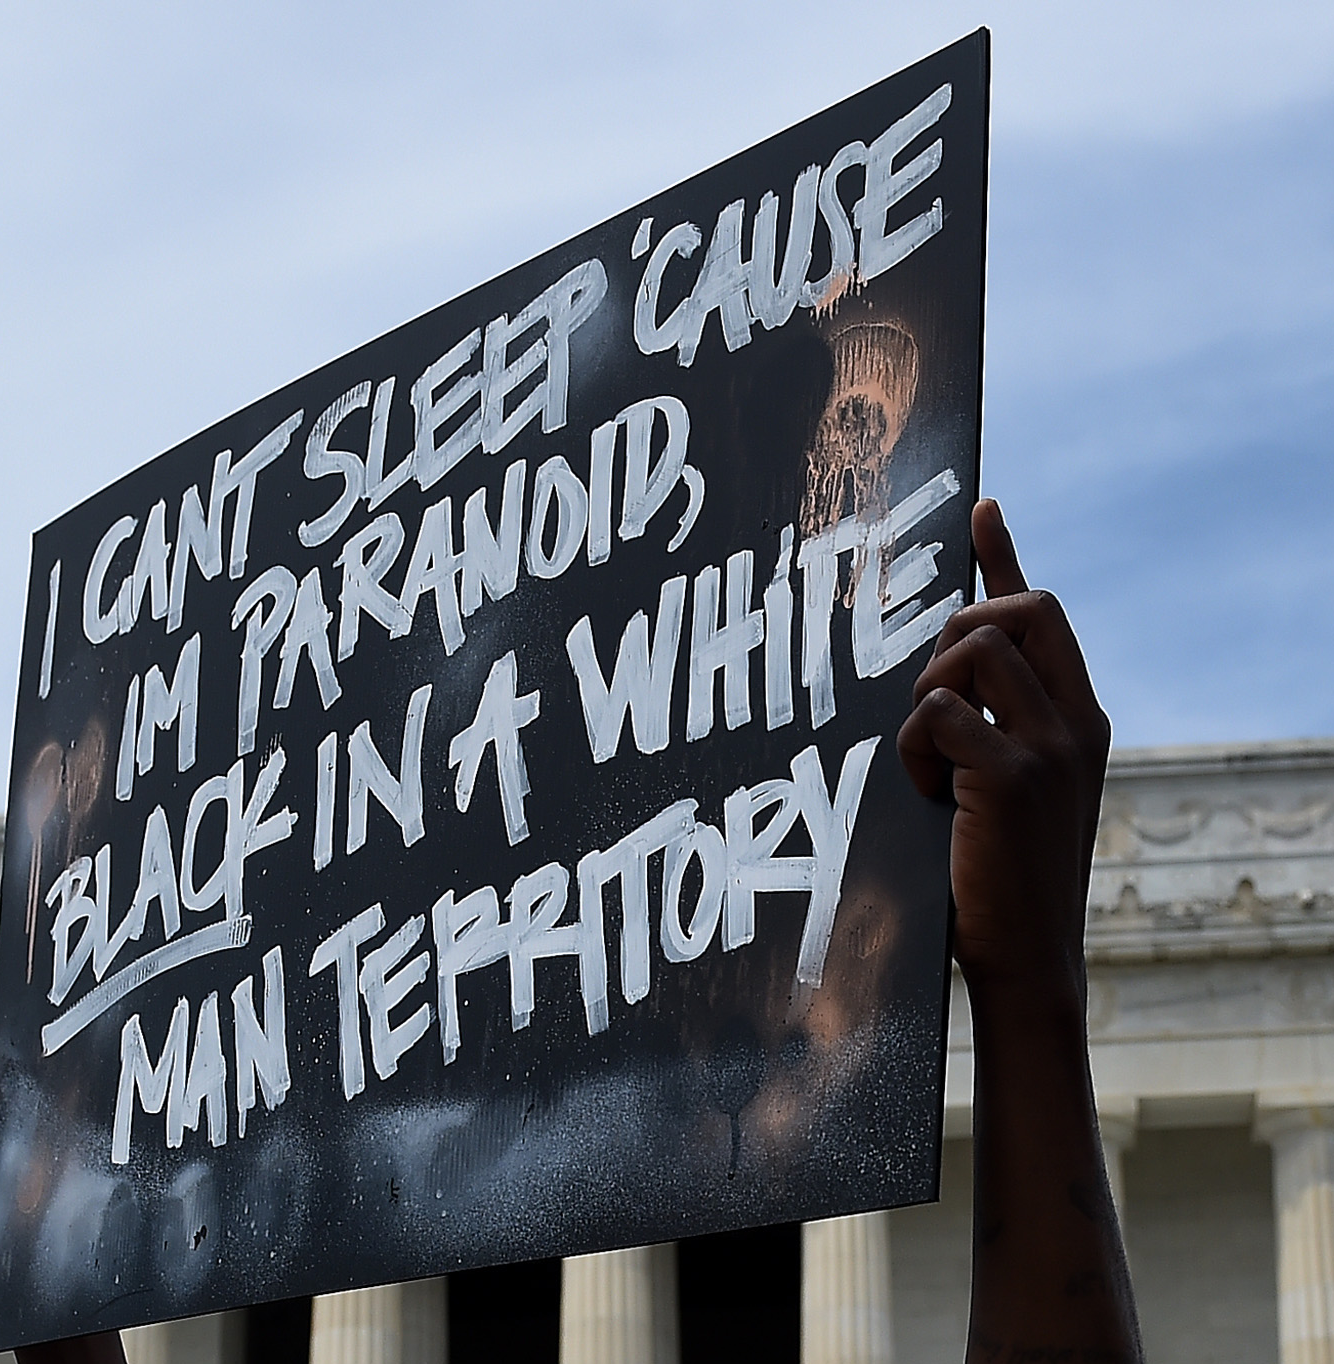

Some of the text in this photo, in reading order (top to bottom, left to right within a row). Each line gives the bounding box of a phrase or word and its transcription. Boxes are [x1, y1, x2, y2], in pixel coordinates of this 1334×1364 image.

[232, 396, 705, 754] PARANOID,
[298, 258, 608, 546] SLEEP
[43, 468, 961, 1005] BLACK IN A WHITE
[111, 735, 882, 1164] MAN TERRITORY
